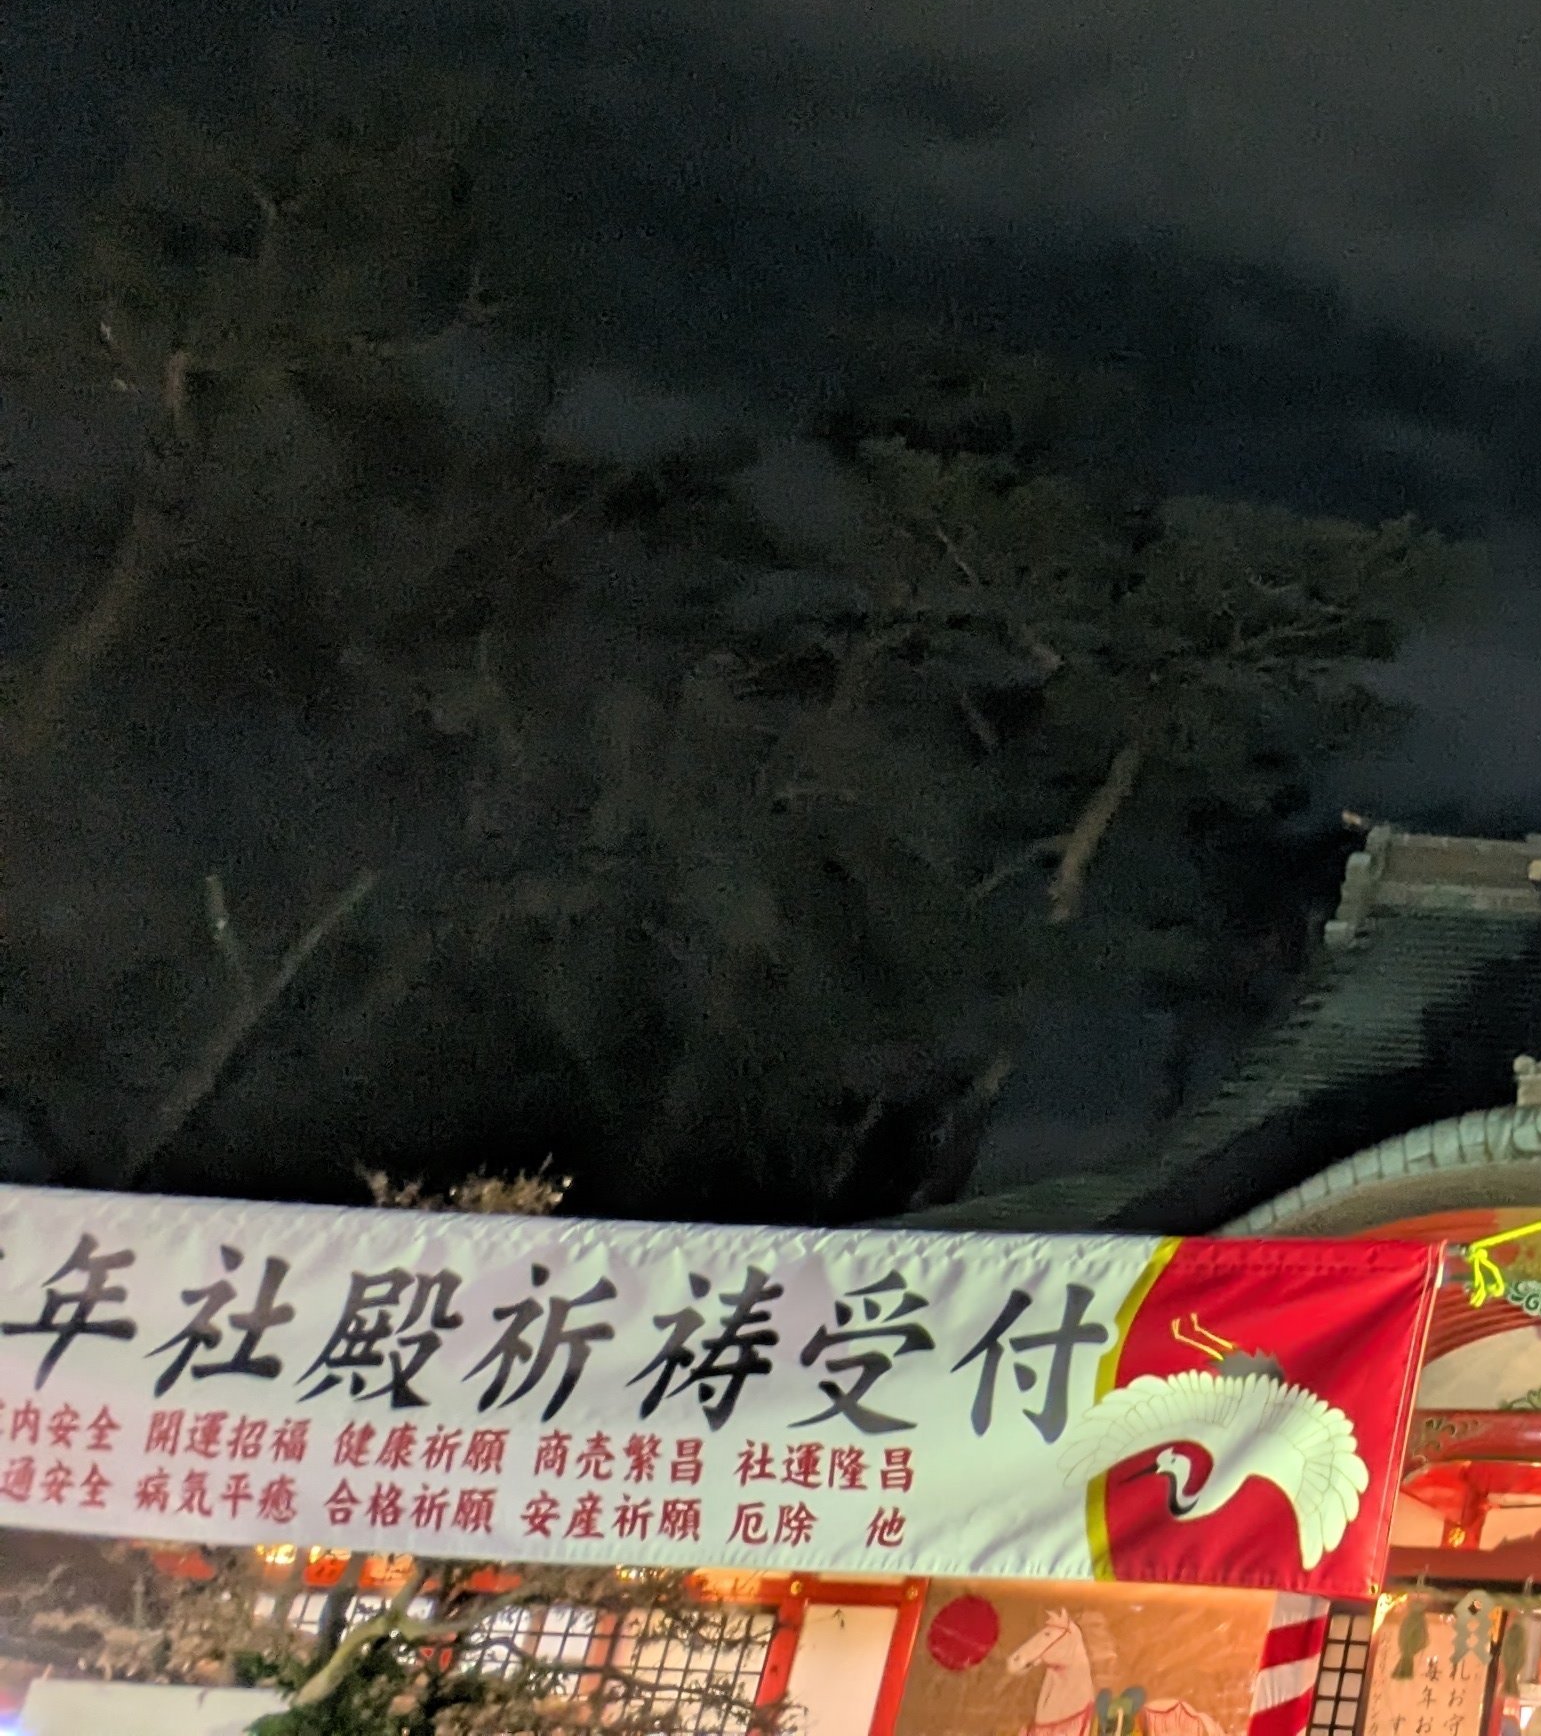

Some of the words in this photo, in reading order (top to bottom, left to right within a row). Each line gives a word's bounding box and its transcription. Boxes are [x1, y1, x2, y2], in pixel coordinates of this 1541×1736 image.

[0, 1400, 122, 1452] 内安全
[144, 1409, 313, 1464] 開運招福
[333, 1419, 509, 1477] 健康祈願
[534, 1428, 705, 1486] 商売繁昌
[738, 1439, 915, 1493] 社運隆昌
[134, 1467, 300, 1524] 病気平癒
[325, 1478, 499, 1534] 合格祈願
[520, 1489, 702, 1543] 安産祈願
[726, 1501, 819, 1548] 厄除
[866, 1507, 905, 1549] 他
